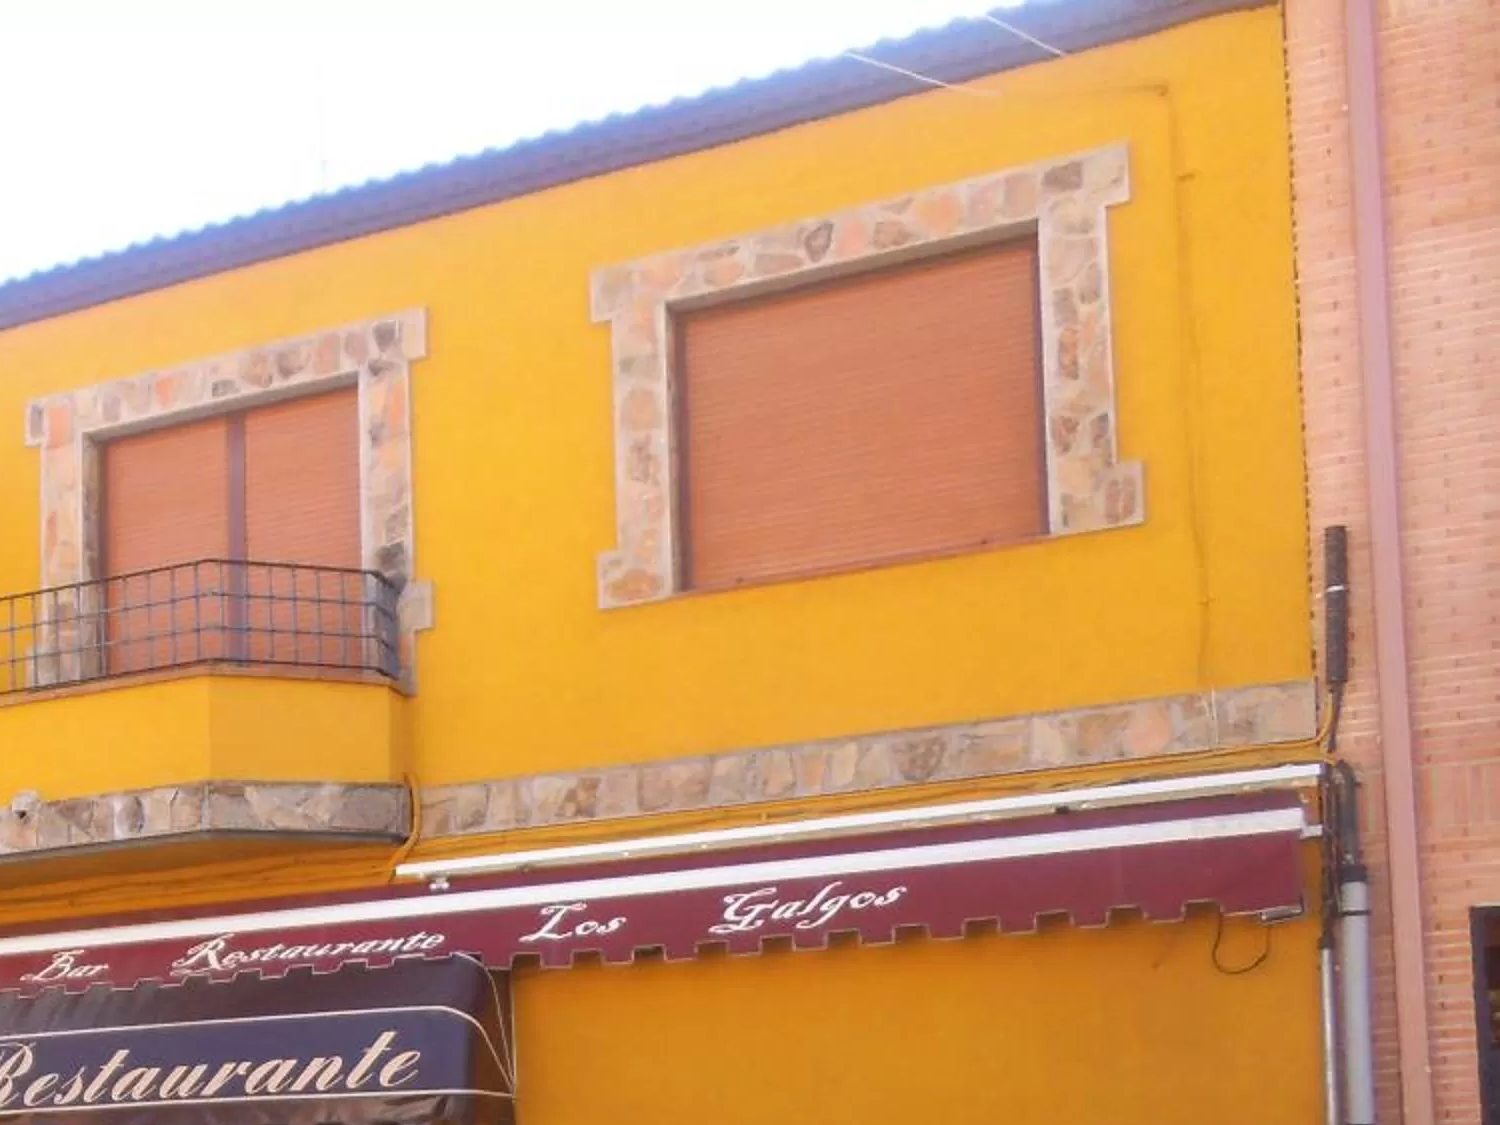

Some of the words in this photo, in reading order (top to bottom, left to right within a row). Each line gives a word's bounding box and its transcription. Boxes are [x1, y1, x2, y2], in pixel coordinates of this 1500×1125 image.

[19, 949, 110, 983] Bar
[169, 931, 446, 977] Restaurante
[518, 901, 627, 943] Los
[708, 880, 908, 935] Galgos
